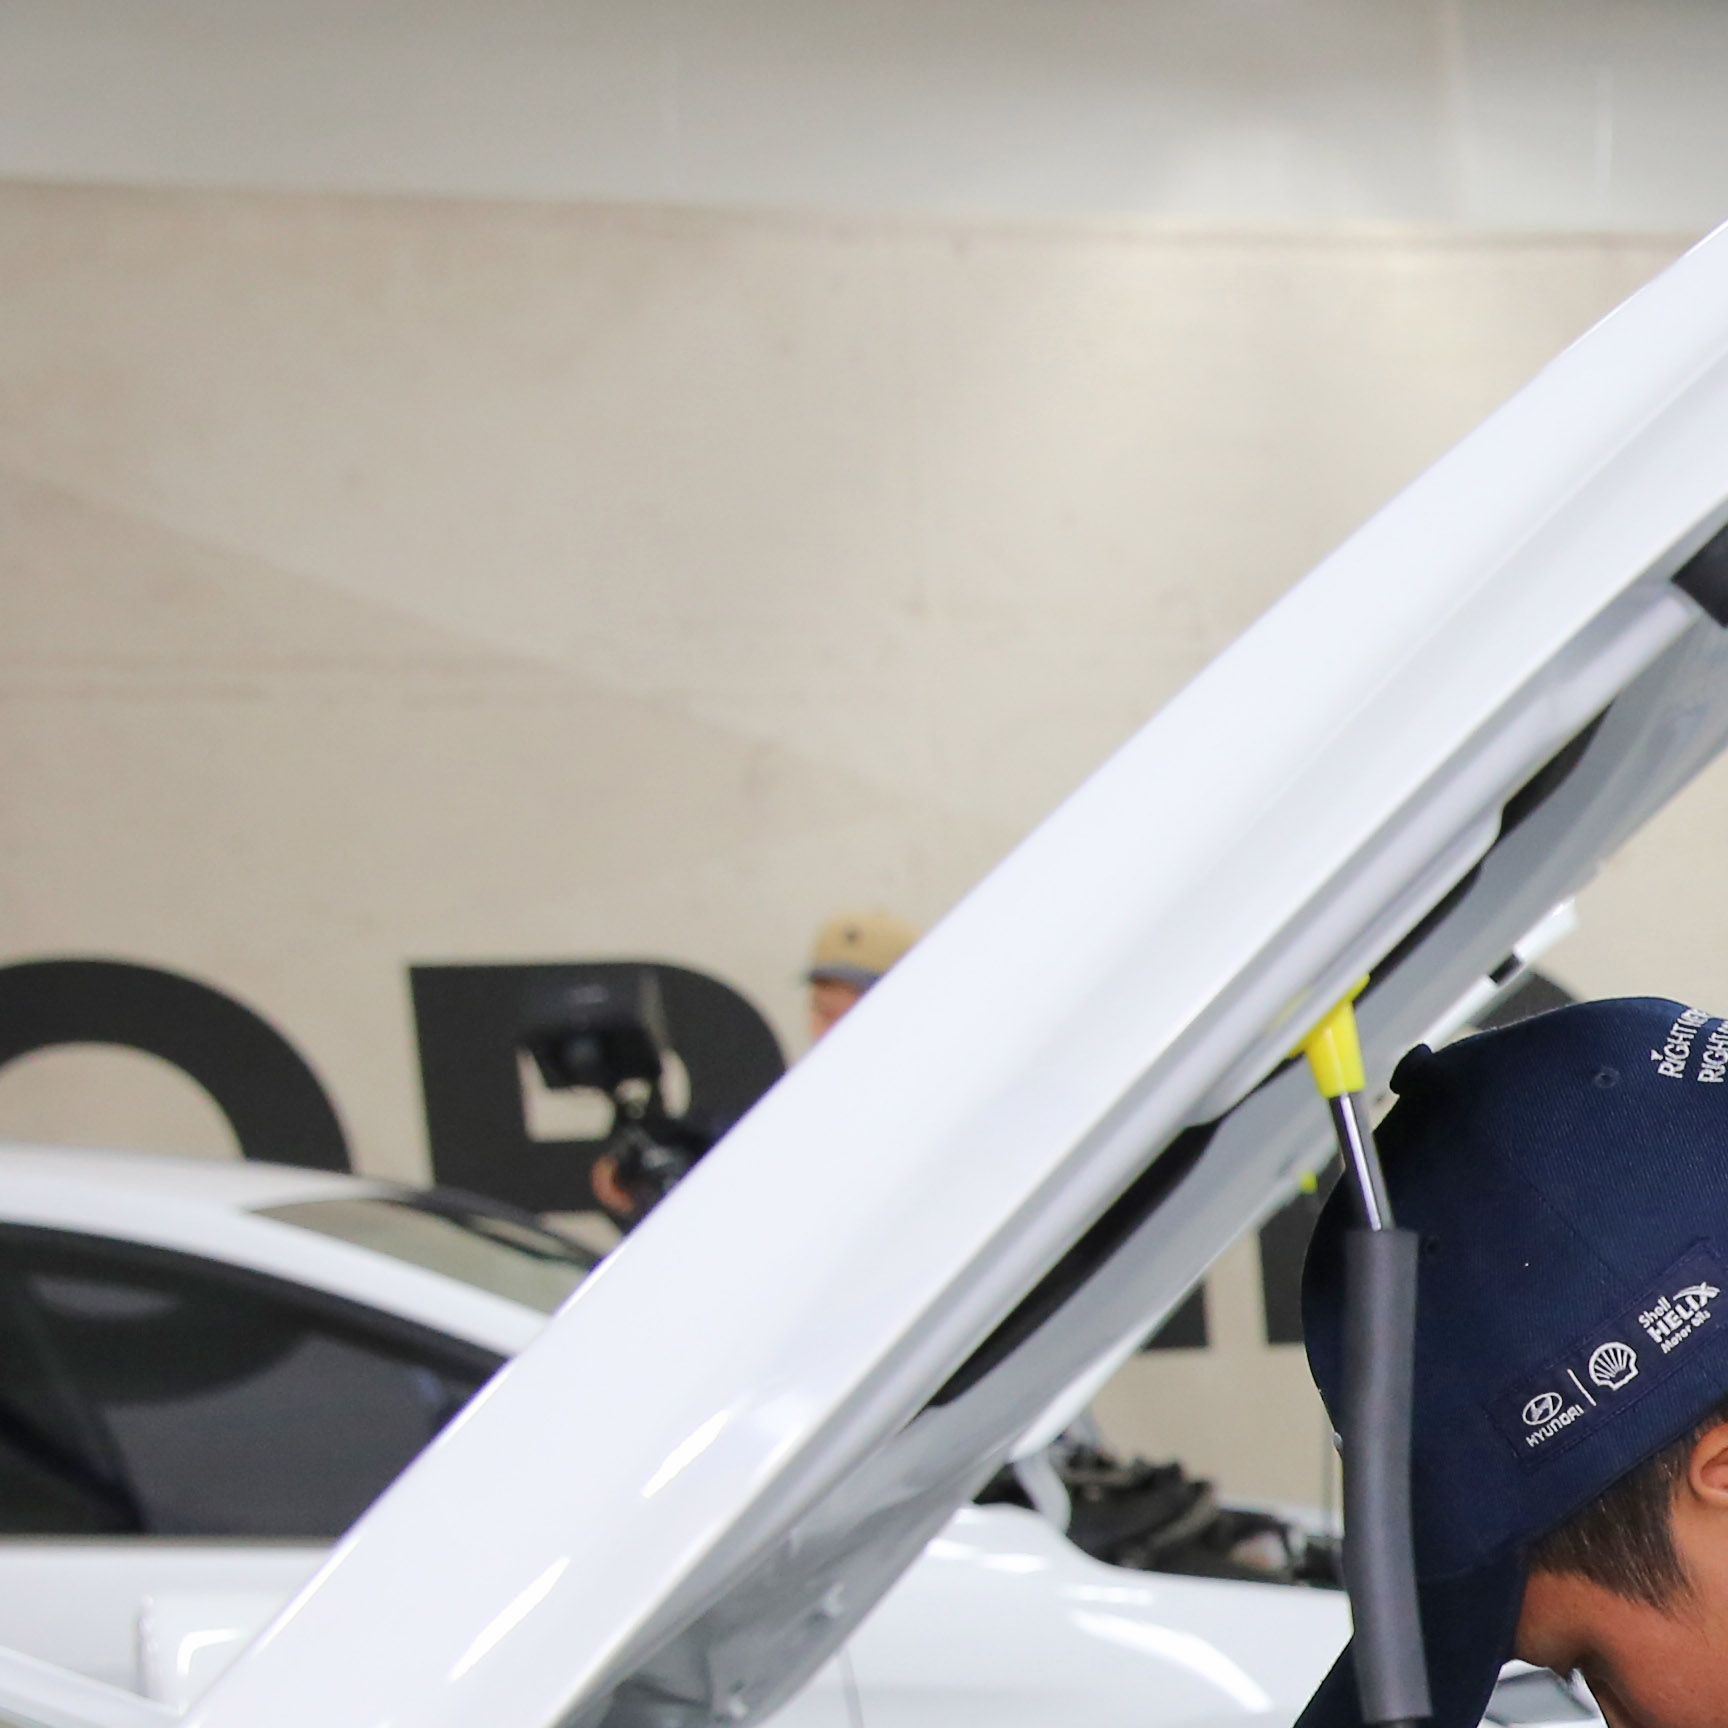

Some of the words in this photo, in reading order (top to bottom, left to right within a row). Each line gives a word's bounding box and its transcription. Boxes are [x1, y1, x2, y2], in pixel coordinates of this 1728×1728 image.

[1638, 1296, 1672, 1329] Shell
[1646, 1281, 1721, 1343] HELIX
[1660, 1324, 1692, 1354] Motor
[1525, 1404, 1585, 1448] HYUNDAI
